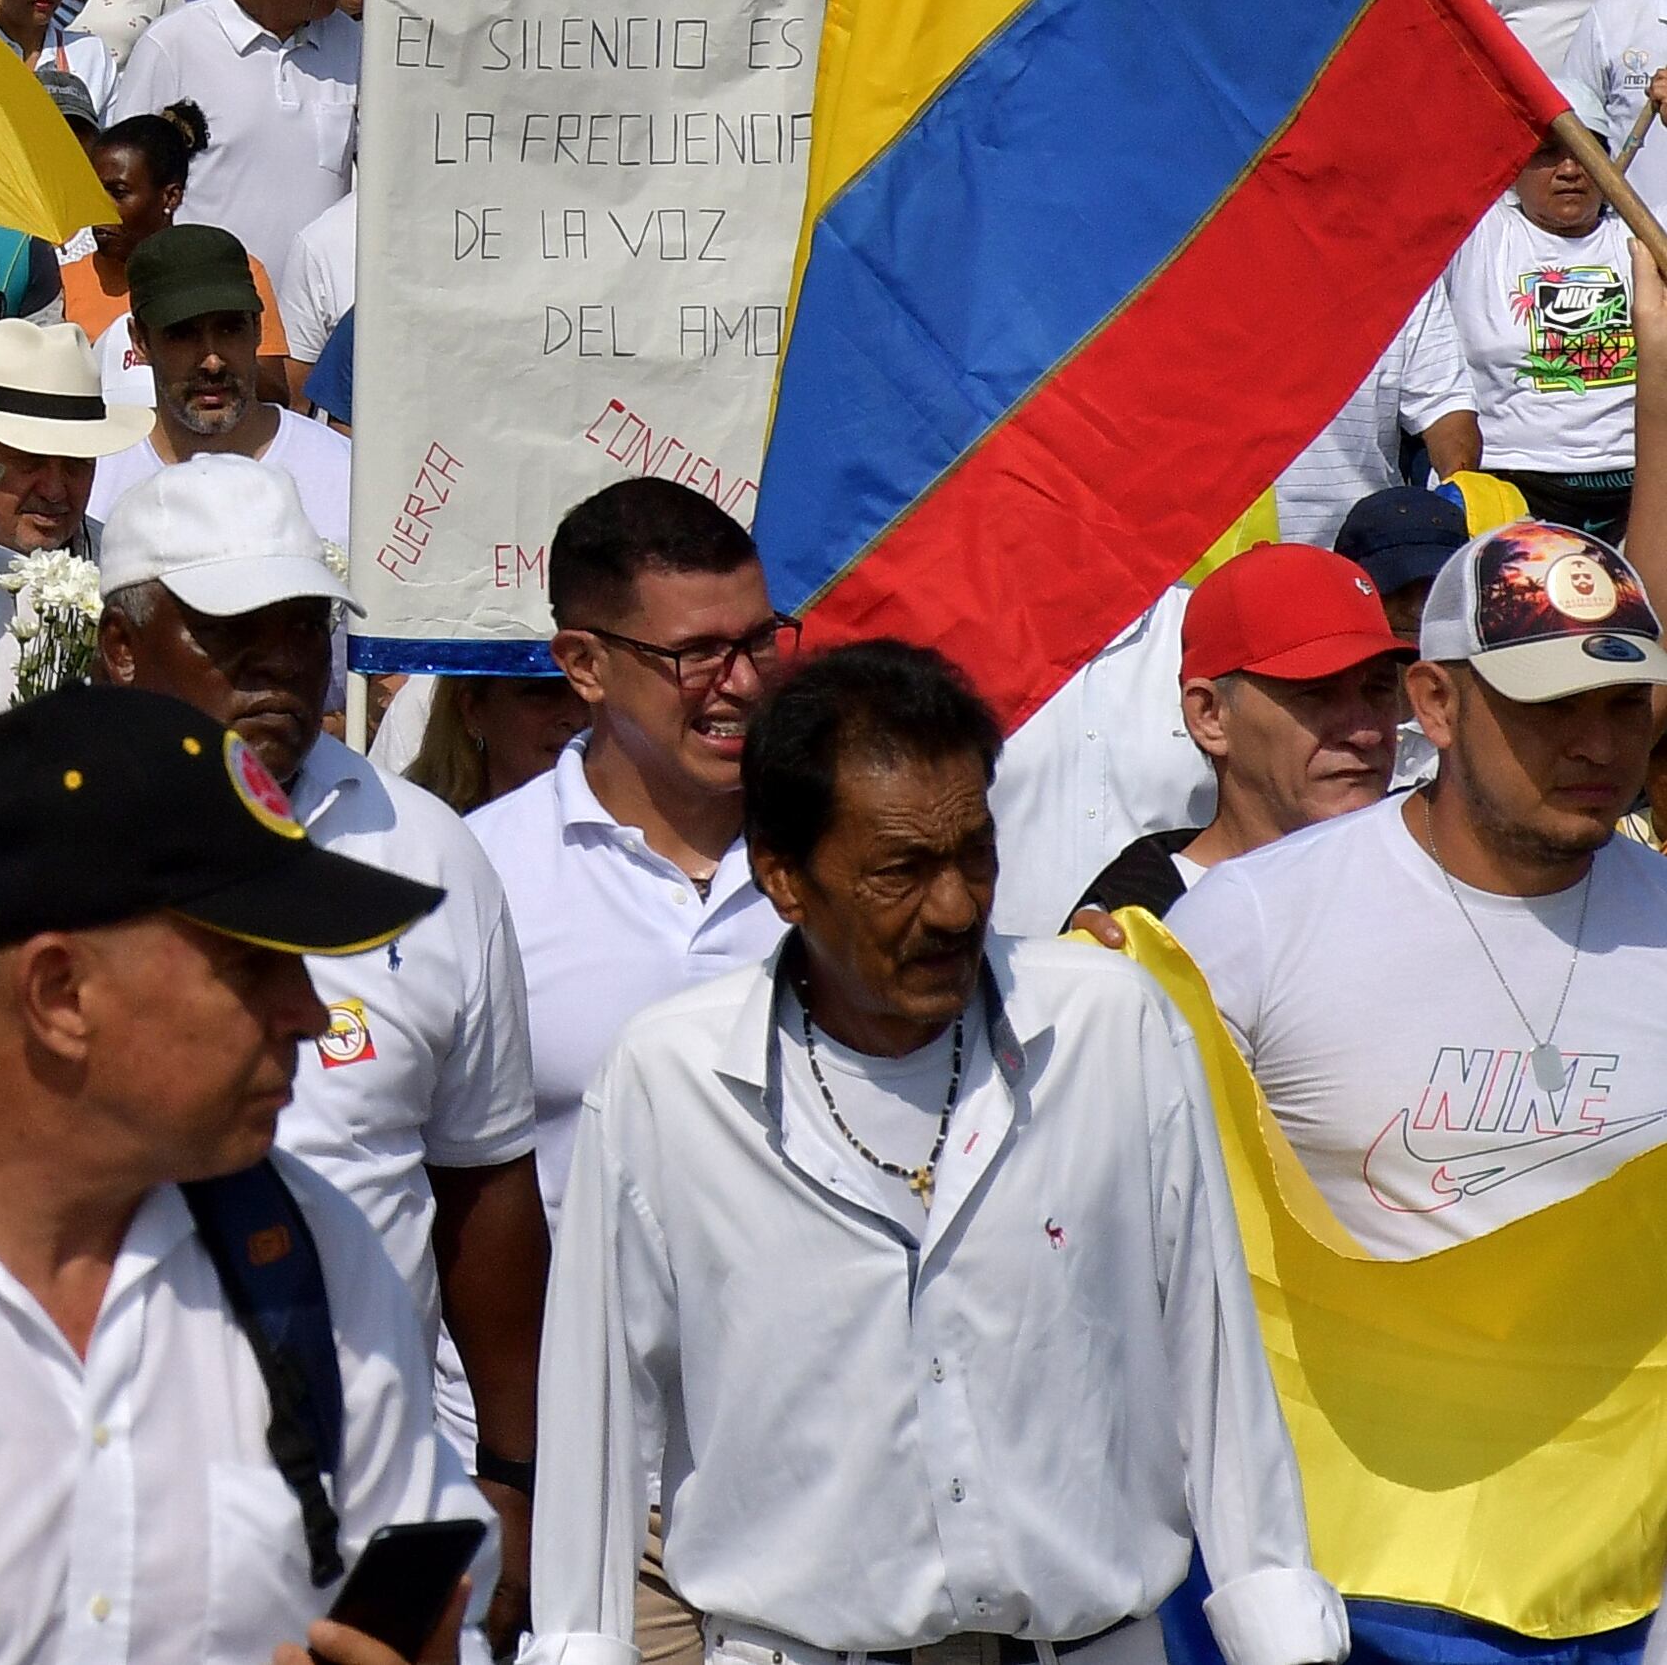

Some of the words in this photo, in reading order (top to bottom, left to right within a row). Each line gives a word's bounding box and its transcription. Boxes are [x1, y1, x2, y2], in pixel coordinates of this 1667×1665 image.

[395, 16, 445, 69] EL
[481, 17, 708, 71] SILENCIO
[748, 17, 805, 70] ES
[434, 112, 495, 165] LA
[453, 207, 503, 262] DE
[541, 208, 588, 260] LA
[608, 208, 727, 262] VOZ
[1553, 287, 1607, 309] NIKE
[543, 304, 637, 357] DEL
[679, 305, 788, 357] AMO
[376, 440, 465, 582] FUERZA
[1412, 1046, 1620, 1137] NIKE
